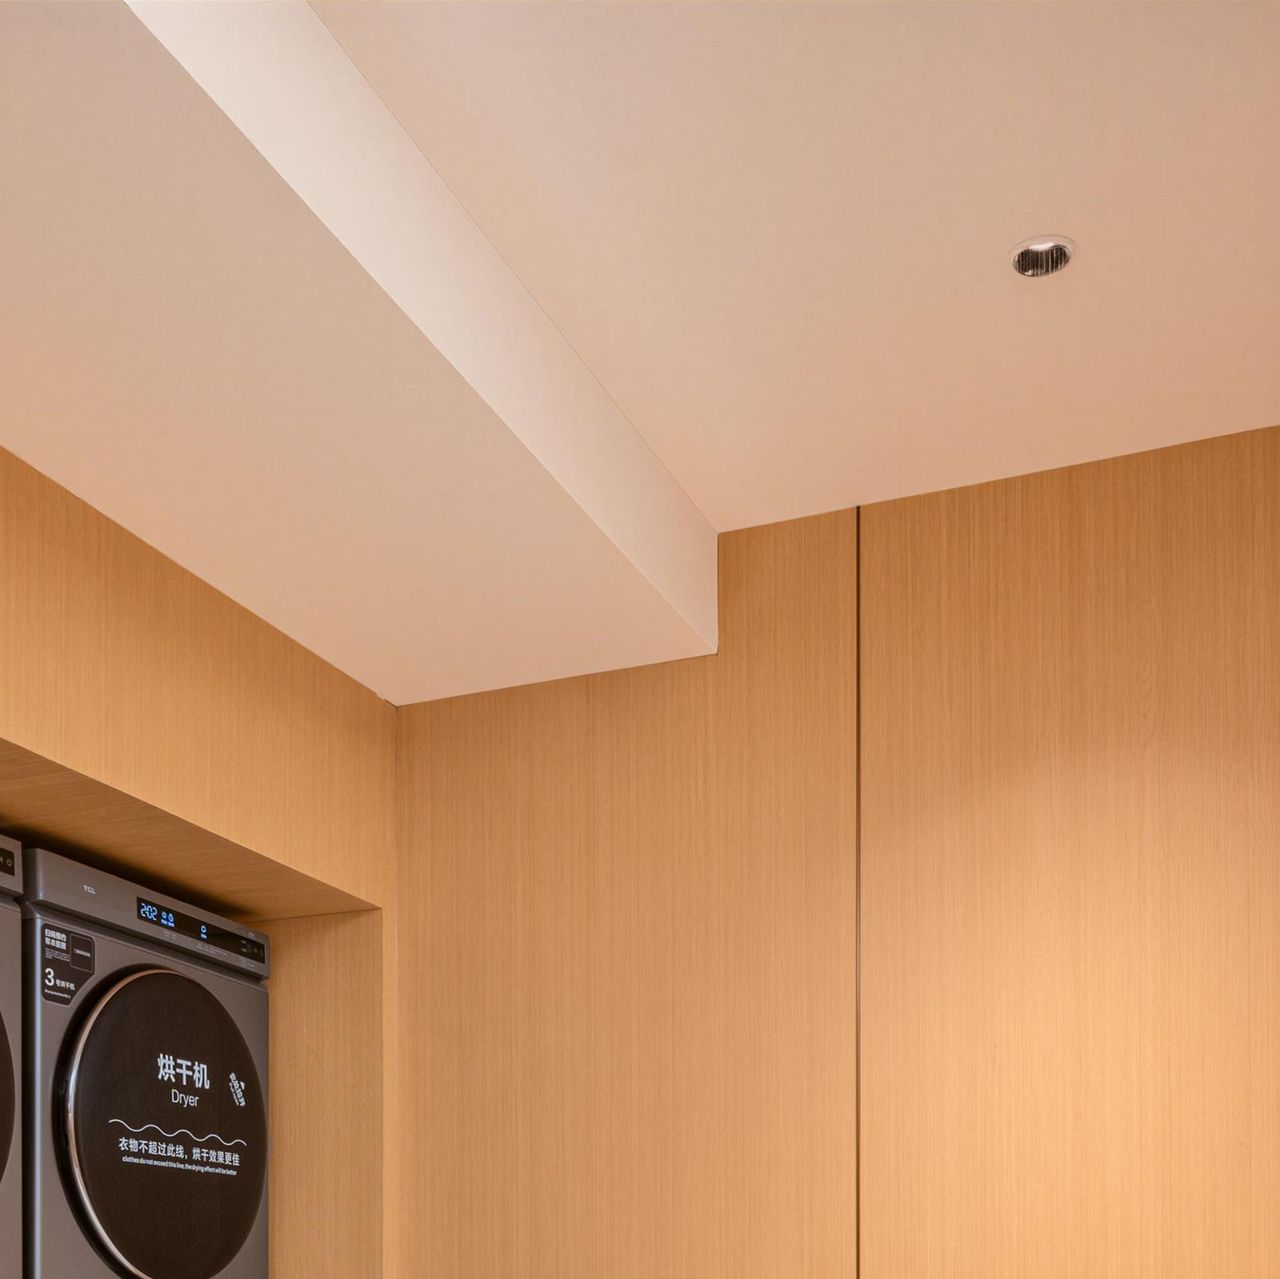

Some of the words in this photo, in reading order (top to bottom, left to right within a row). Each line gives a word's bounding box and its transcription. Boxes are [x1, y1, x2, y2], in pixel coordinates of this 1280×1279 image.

[84, 885, 96, 894] TCL
[44, 968, 54, 986] 3
[157, 1053, 210, 1090] 烘干机
[172, 1089, 200, 1108] Dryer
[119, 1136, 240, 1166] 衣物不超过此线，烘干效果更佳
